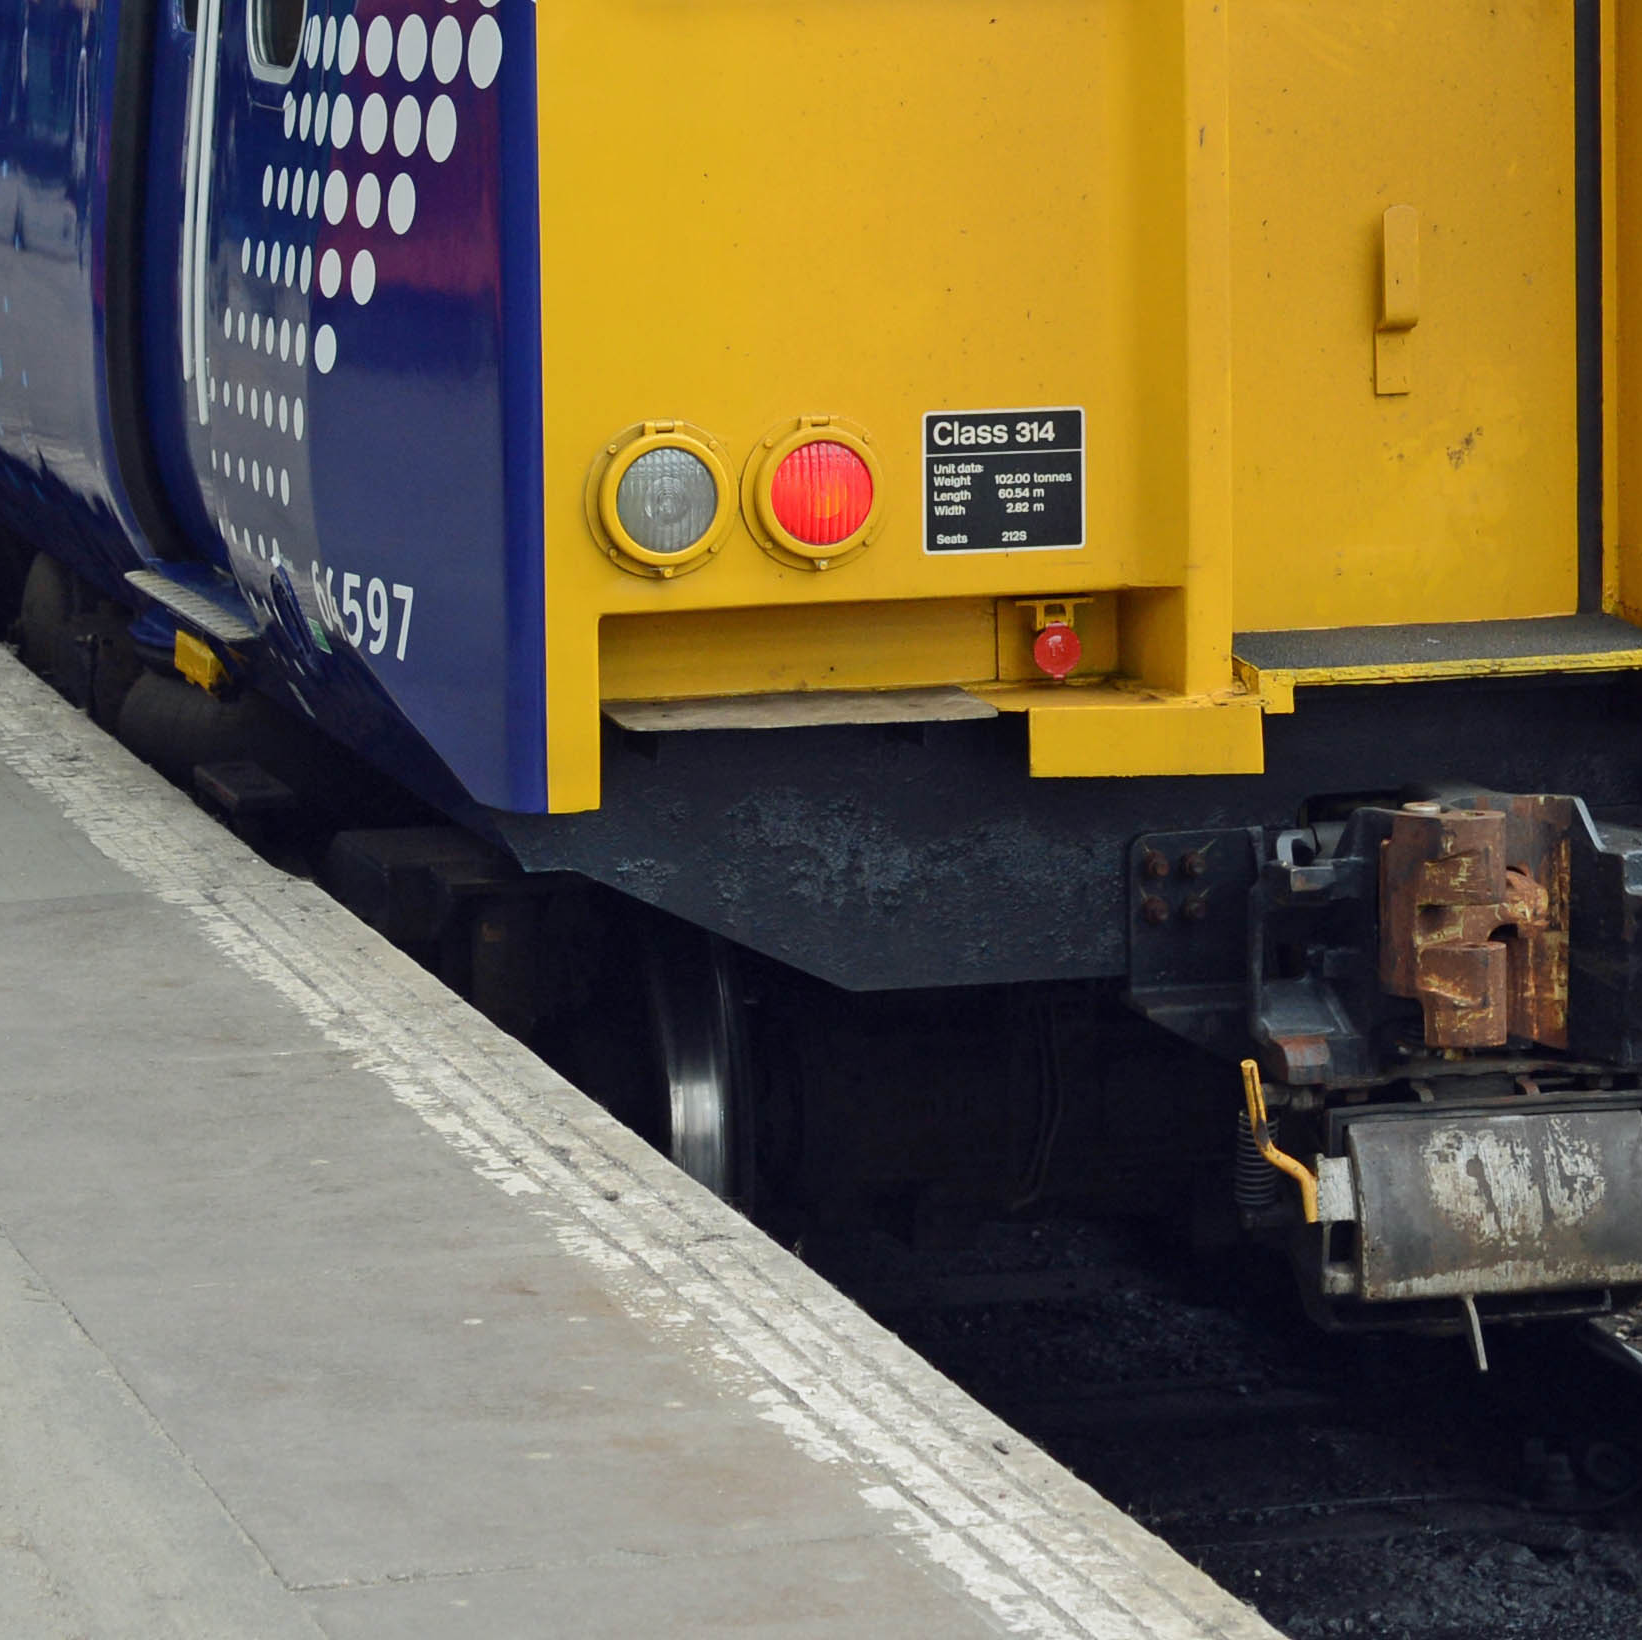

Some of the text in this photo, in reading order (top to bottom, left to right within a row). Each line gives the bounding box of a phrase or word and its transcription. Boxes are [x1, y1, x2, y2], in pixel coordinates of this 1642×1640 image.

[933, 421, 1055, 446] Class 314
[934, 463, 985, 475] Unit data:
[934, 472, 1072, 488] Weight 102.00 tonnes
[934, 488, 1045, 502] Length 60.54 m
[934, 502, 1045, 516] Width 2.82 m
[936, 530, 1027, 545] Seats 212S
[311, 560, 414, 661] 64597
